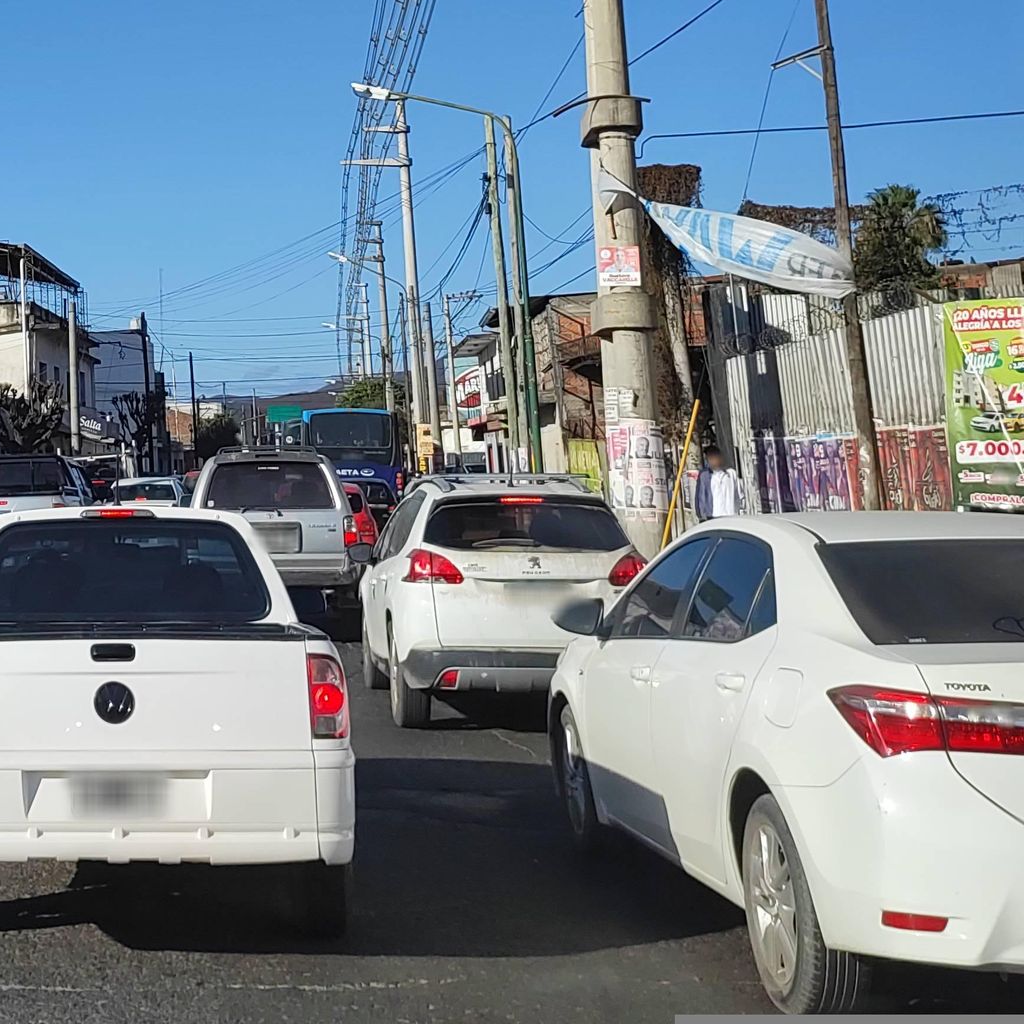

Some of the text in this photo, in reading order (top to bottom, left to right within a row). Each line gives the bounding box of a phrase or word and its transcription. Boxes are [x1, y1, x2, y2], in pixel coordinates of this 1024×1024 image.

[972, 306, 1005, 320] AÑOS
[992, 320, 1001, 329] A
[1002, 319, 1022, 329] LOS
[80, 416, 102, 431] Salta
[944, 682, 992, 692] TOYOTA
